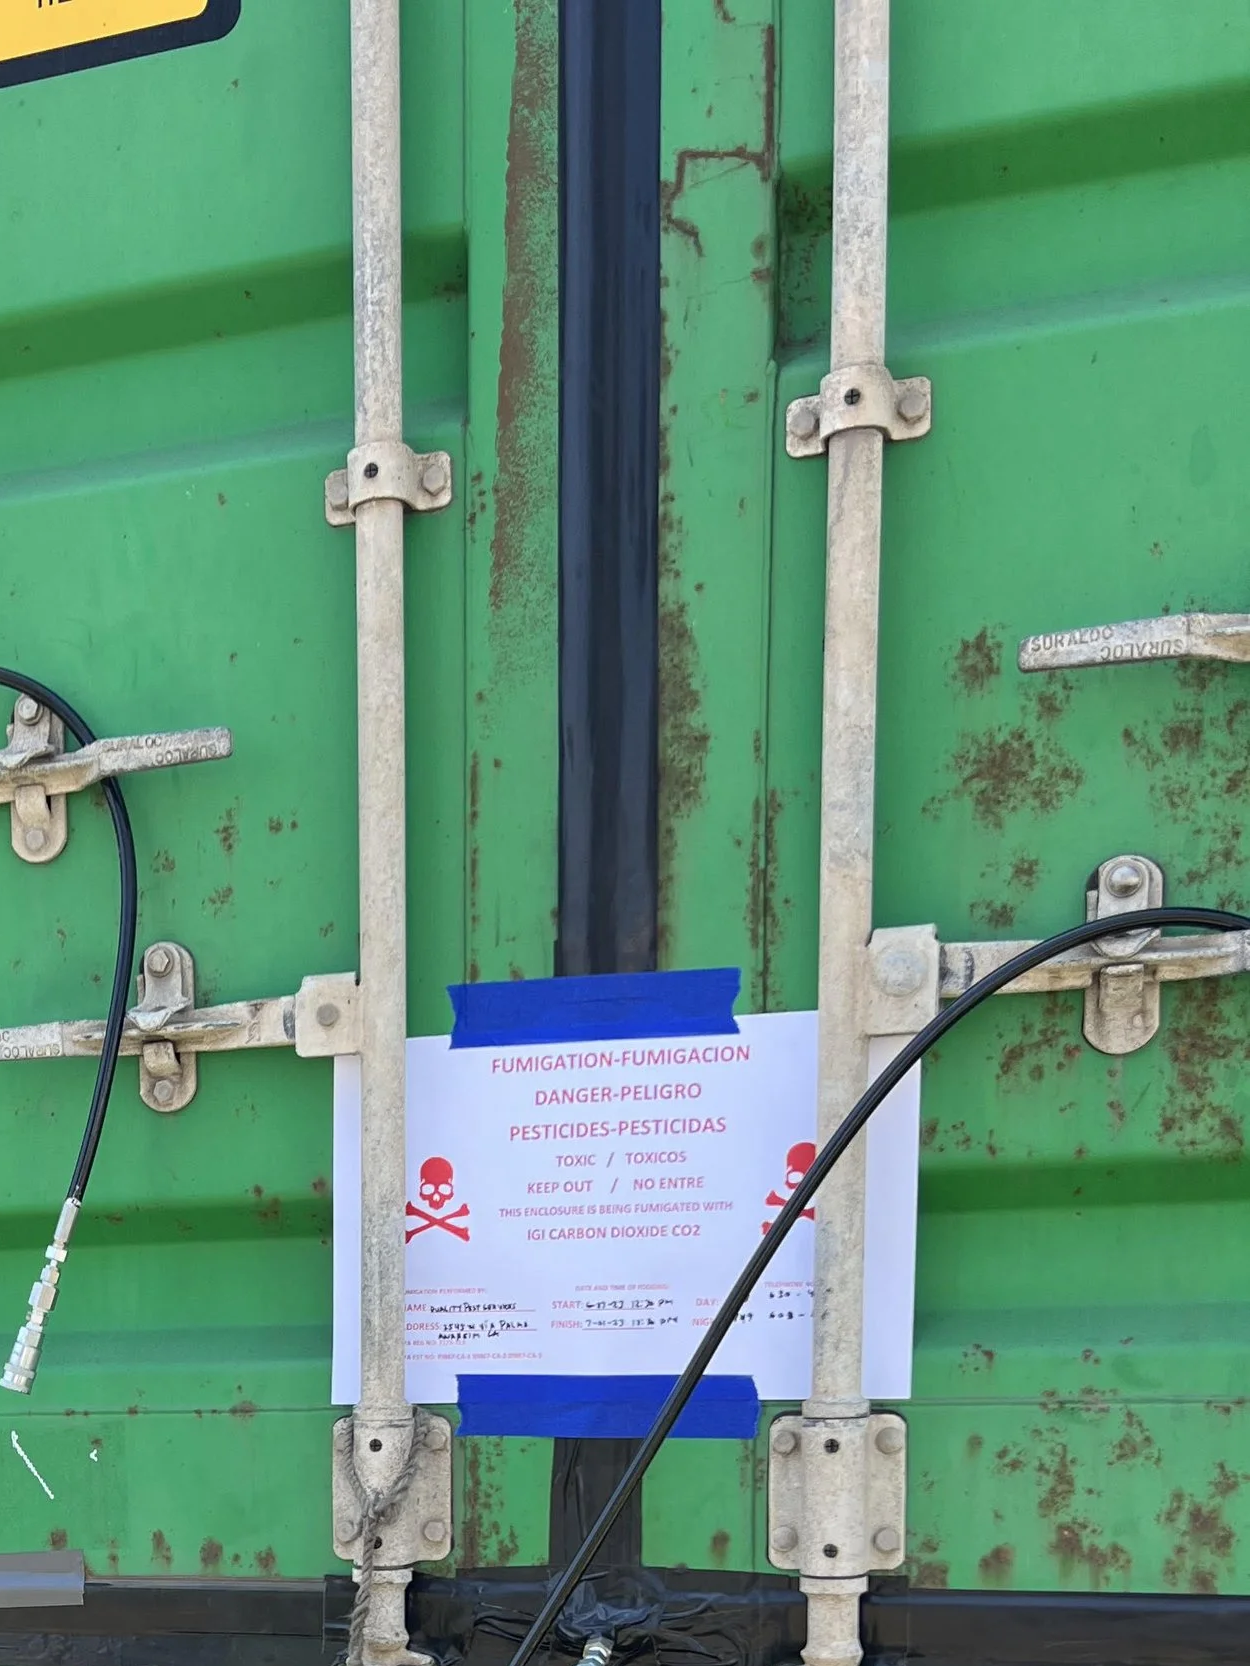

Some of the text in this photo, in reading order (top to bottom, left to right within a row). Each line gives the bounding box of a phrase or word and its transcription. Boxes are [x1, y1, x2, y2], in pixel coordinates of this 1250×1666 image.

[1100, 640, 1184, 660] SURALOC
[492, 1046, 750, 1074] FUMIGATION-FUMIGACION
[535, 1083, 702, 1106] DANGER-PELIGRO
[510, 1117, 726, 1141] PESTICIDES-PESTICIDAS
[556, 1151, 687, 1168] TOXIC / TOXICOS
[527, 1177, 704, 1194] KEEP OUT / NO ENTRE
[500, 1201, 733, 1218] THIS ENCLOSURE IS BEING FUMIGATED WITH
[527, 1224, 701, 1241] IGI CARBON DIOXIDE CO2
[552, 1300, 583, 1309] START:
[696, 1298, 719, 1306] DAY:
[551, 1320, 582, 1329] FINISH:
[692, 1317, 714, 1327] NIG
